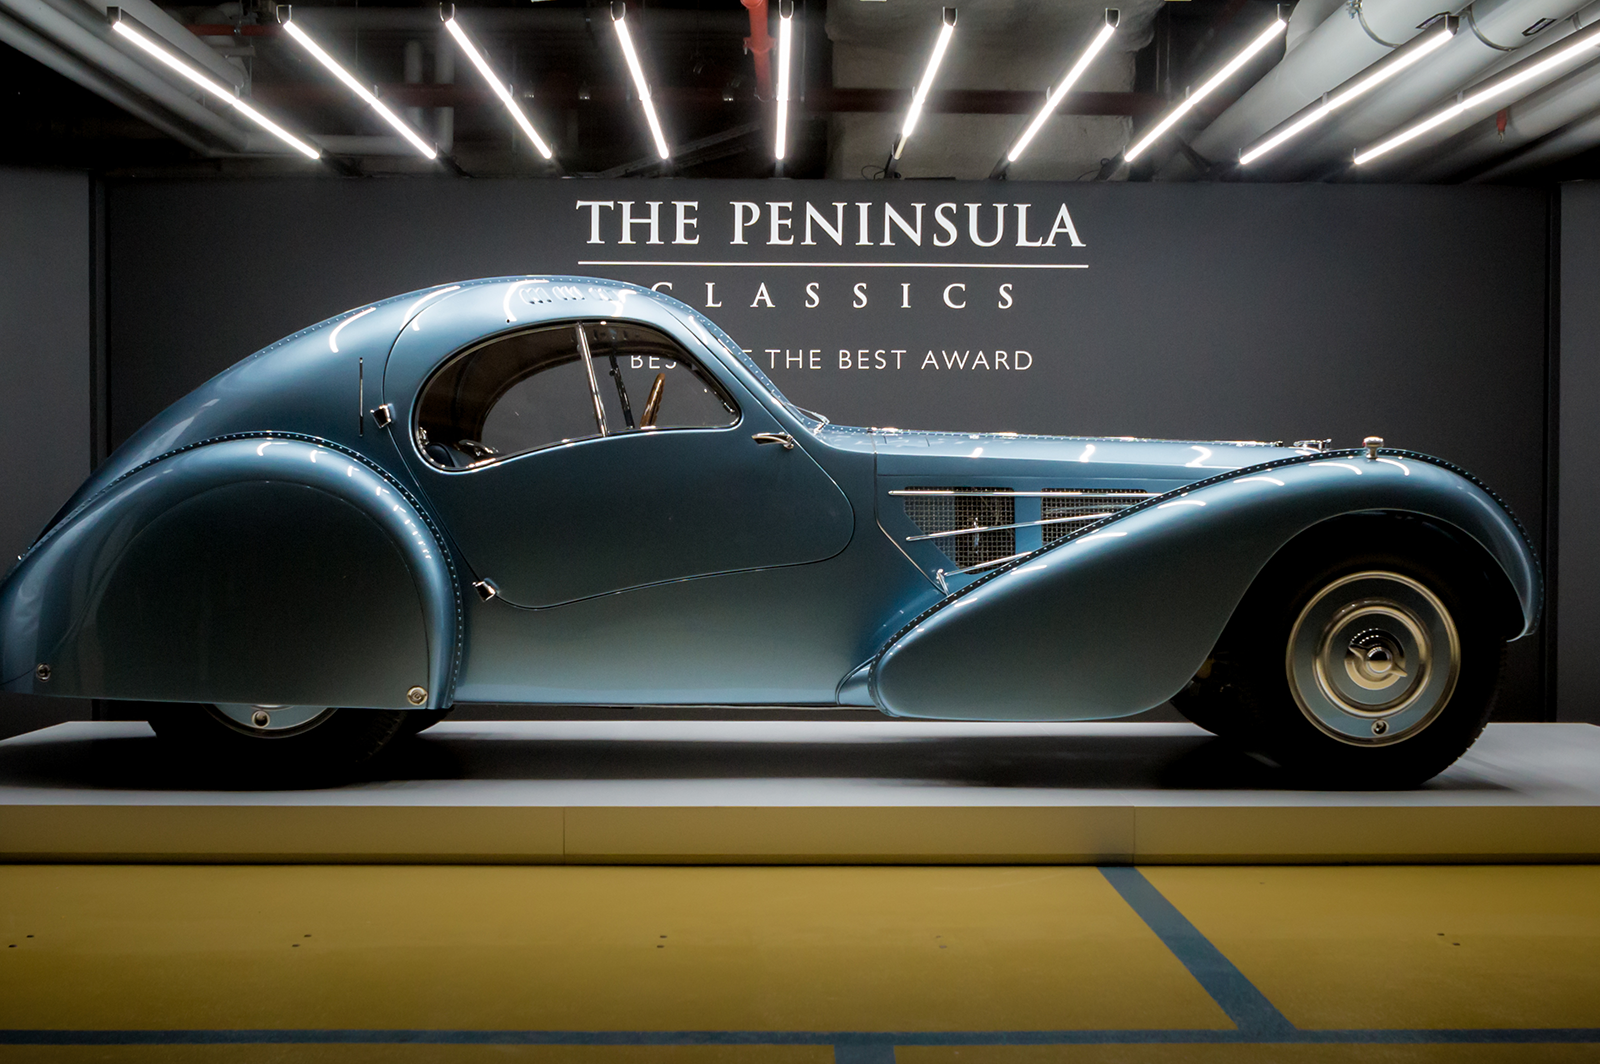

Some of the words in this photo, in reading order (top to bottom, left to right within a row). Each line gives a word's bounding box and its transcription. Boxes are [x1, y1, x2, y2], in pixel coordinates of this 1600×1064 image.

[576, 200, 700, 245] THE
[730, 201, 1087, 248] PENINSULA
[764, 349, 822, 370] THE
[838, 349, 907, 370] BEST
[920, 349, 1033, 371] AWARD
